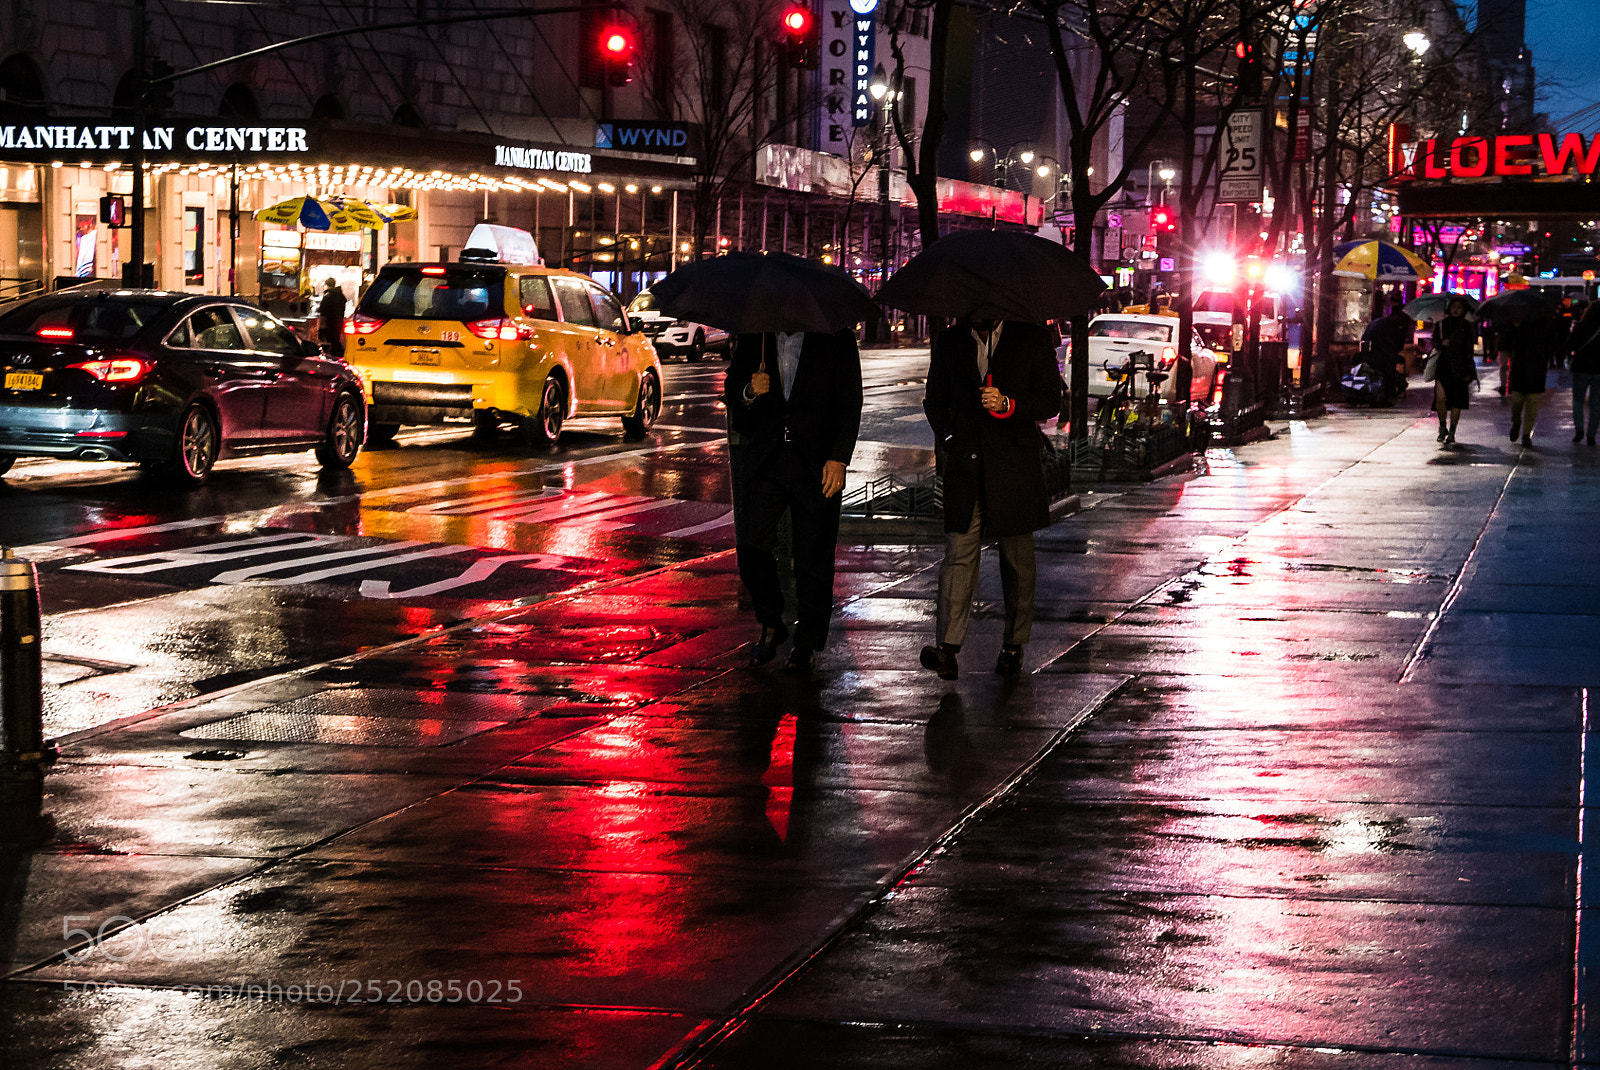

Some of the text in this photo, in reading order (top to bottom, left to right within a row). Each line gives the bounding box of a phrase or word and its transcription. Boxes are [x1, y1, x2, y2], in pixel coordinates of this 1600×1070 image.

[856, 20, 872, 120] WYNDHAM
[1231, 114, 1250, 123] CITY
[186, 127, 309, 152] CENTER
[618, 128, 687, 146] WYND
[495, 145, 592, 173] MANHATTAN CENTER
[1225, 147, 1256, 171] 25
[1425, 132, 1600, 179] LOEW
[442, 331, 460, 341] 189
[59, 531, 570, 599] BUS
